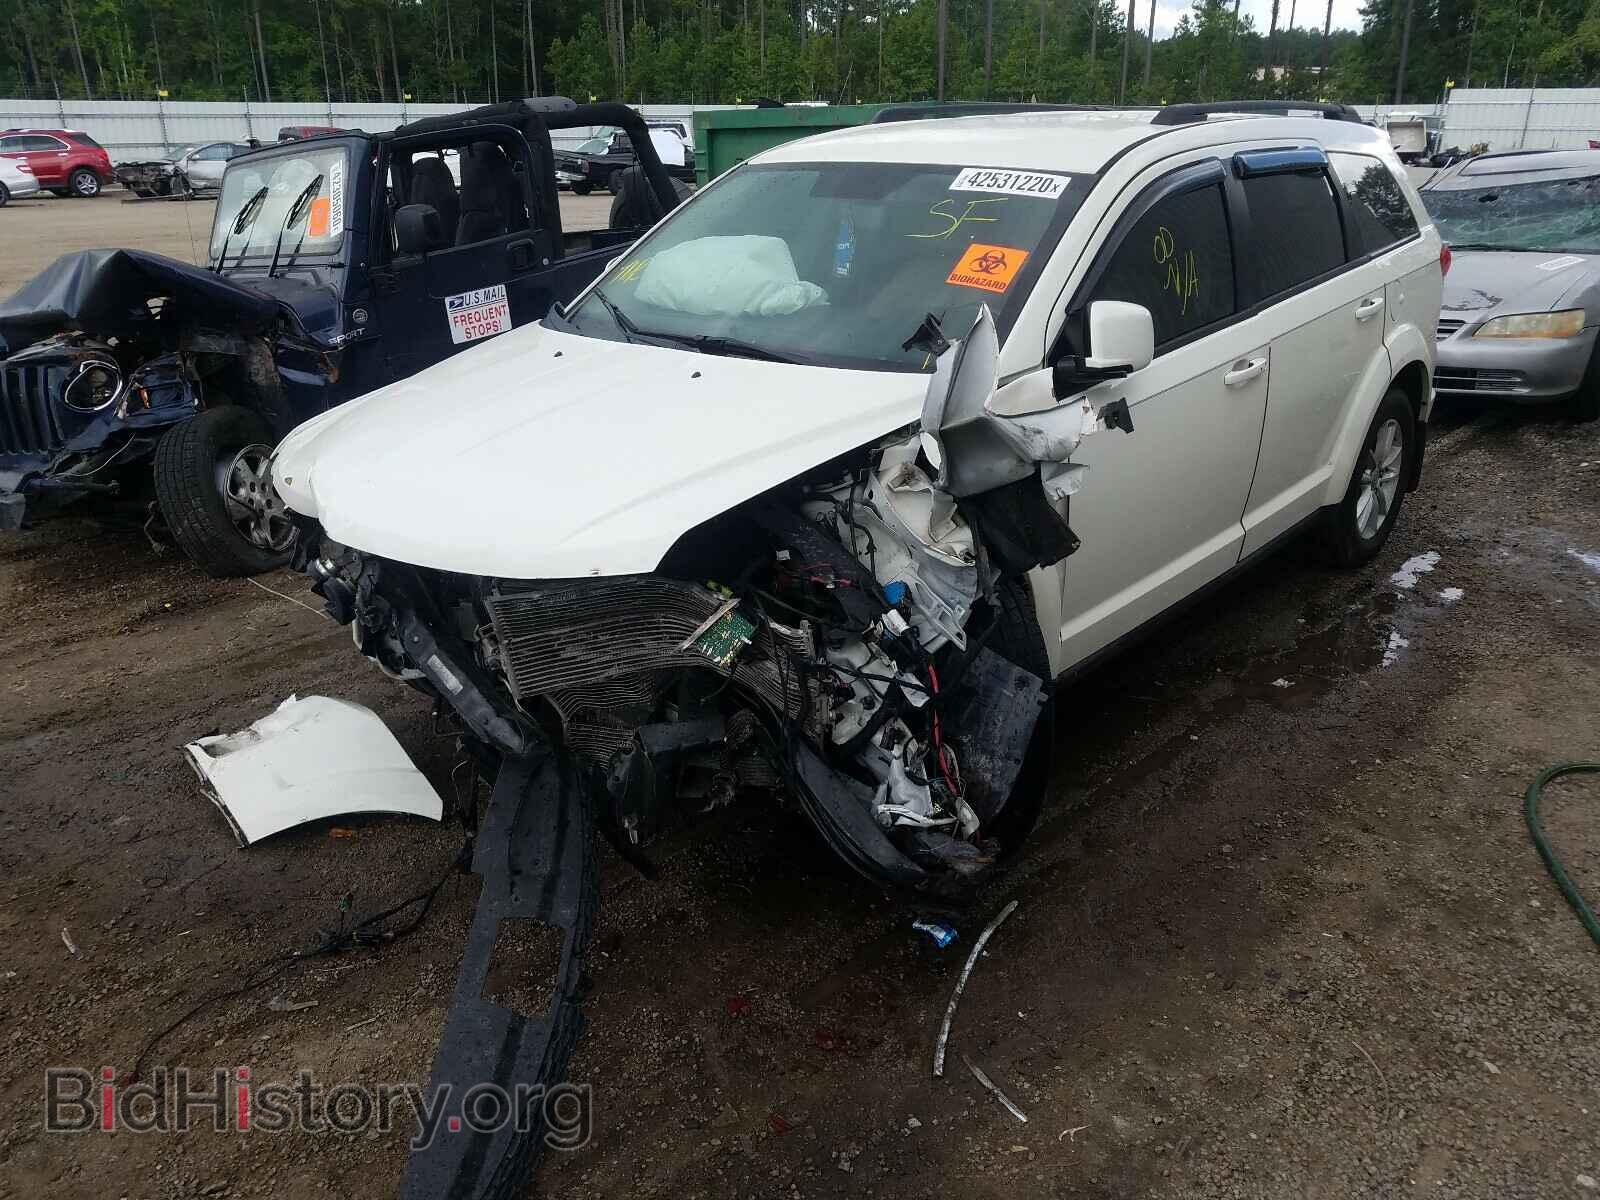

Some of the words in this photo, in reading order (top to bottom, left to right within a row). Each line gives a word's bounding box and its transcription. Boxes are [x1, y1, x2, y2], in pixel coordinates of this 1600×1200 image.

[950, 273, 1007, 290] BIOHAZARD
[453, 304, 507, 328] FREQUENT
[328, 328, 366, 345] SPORT
[465, 320, 503, 340] STOPS!
